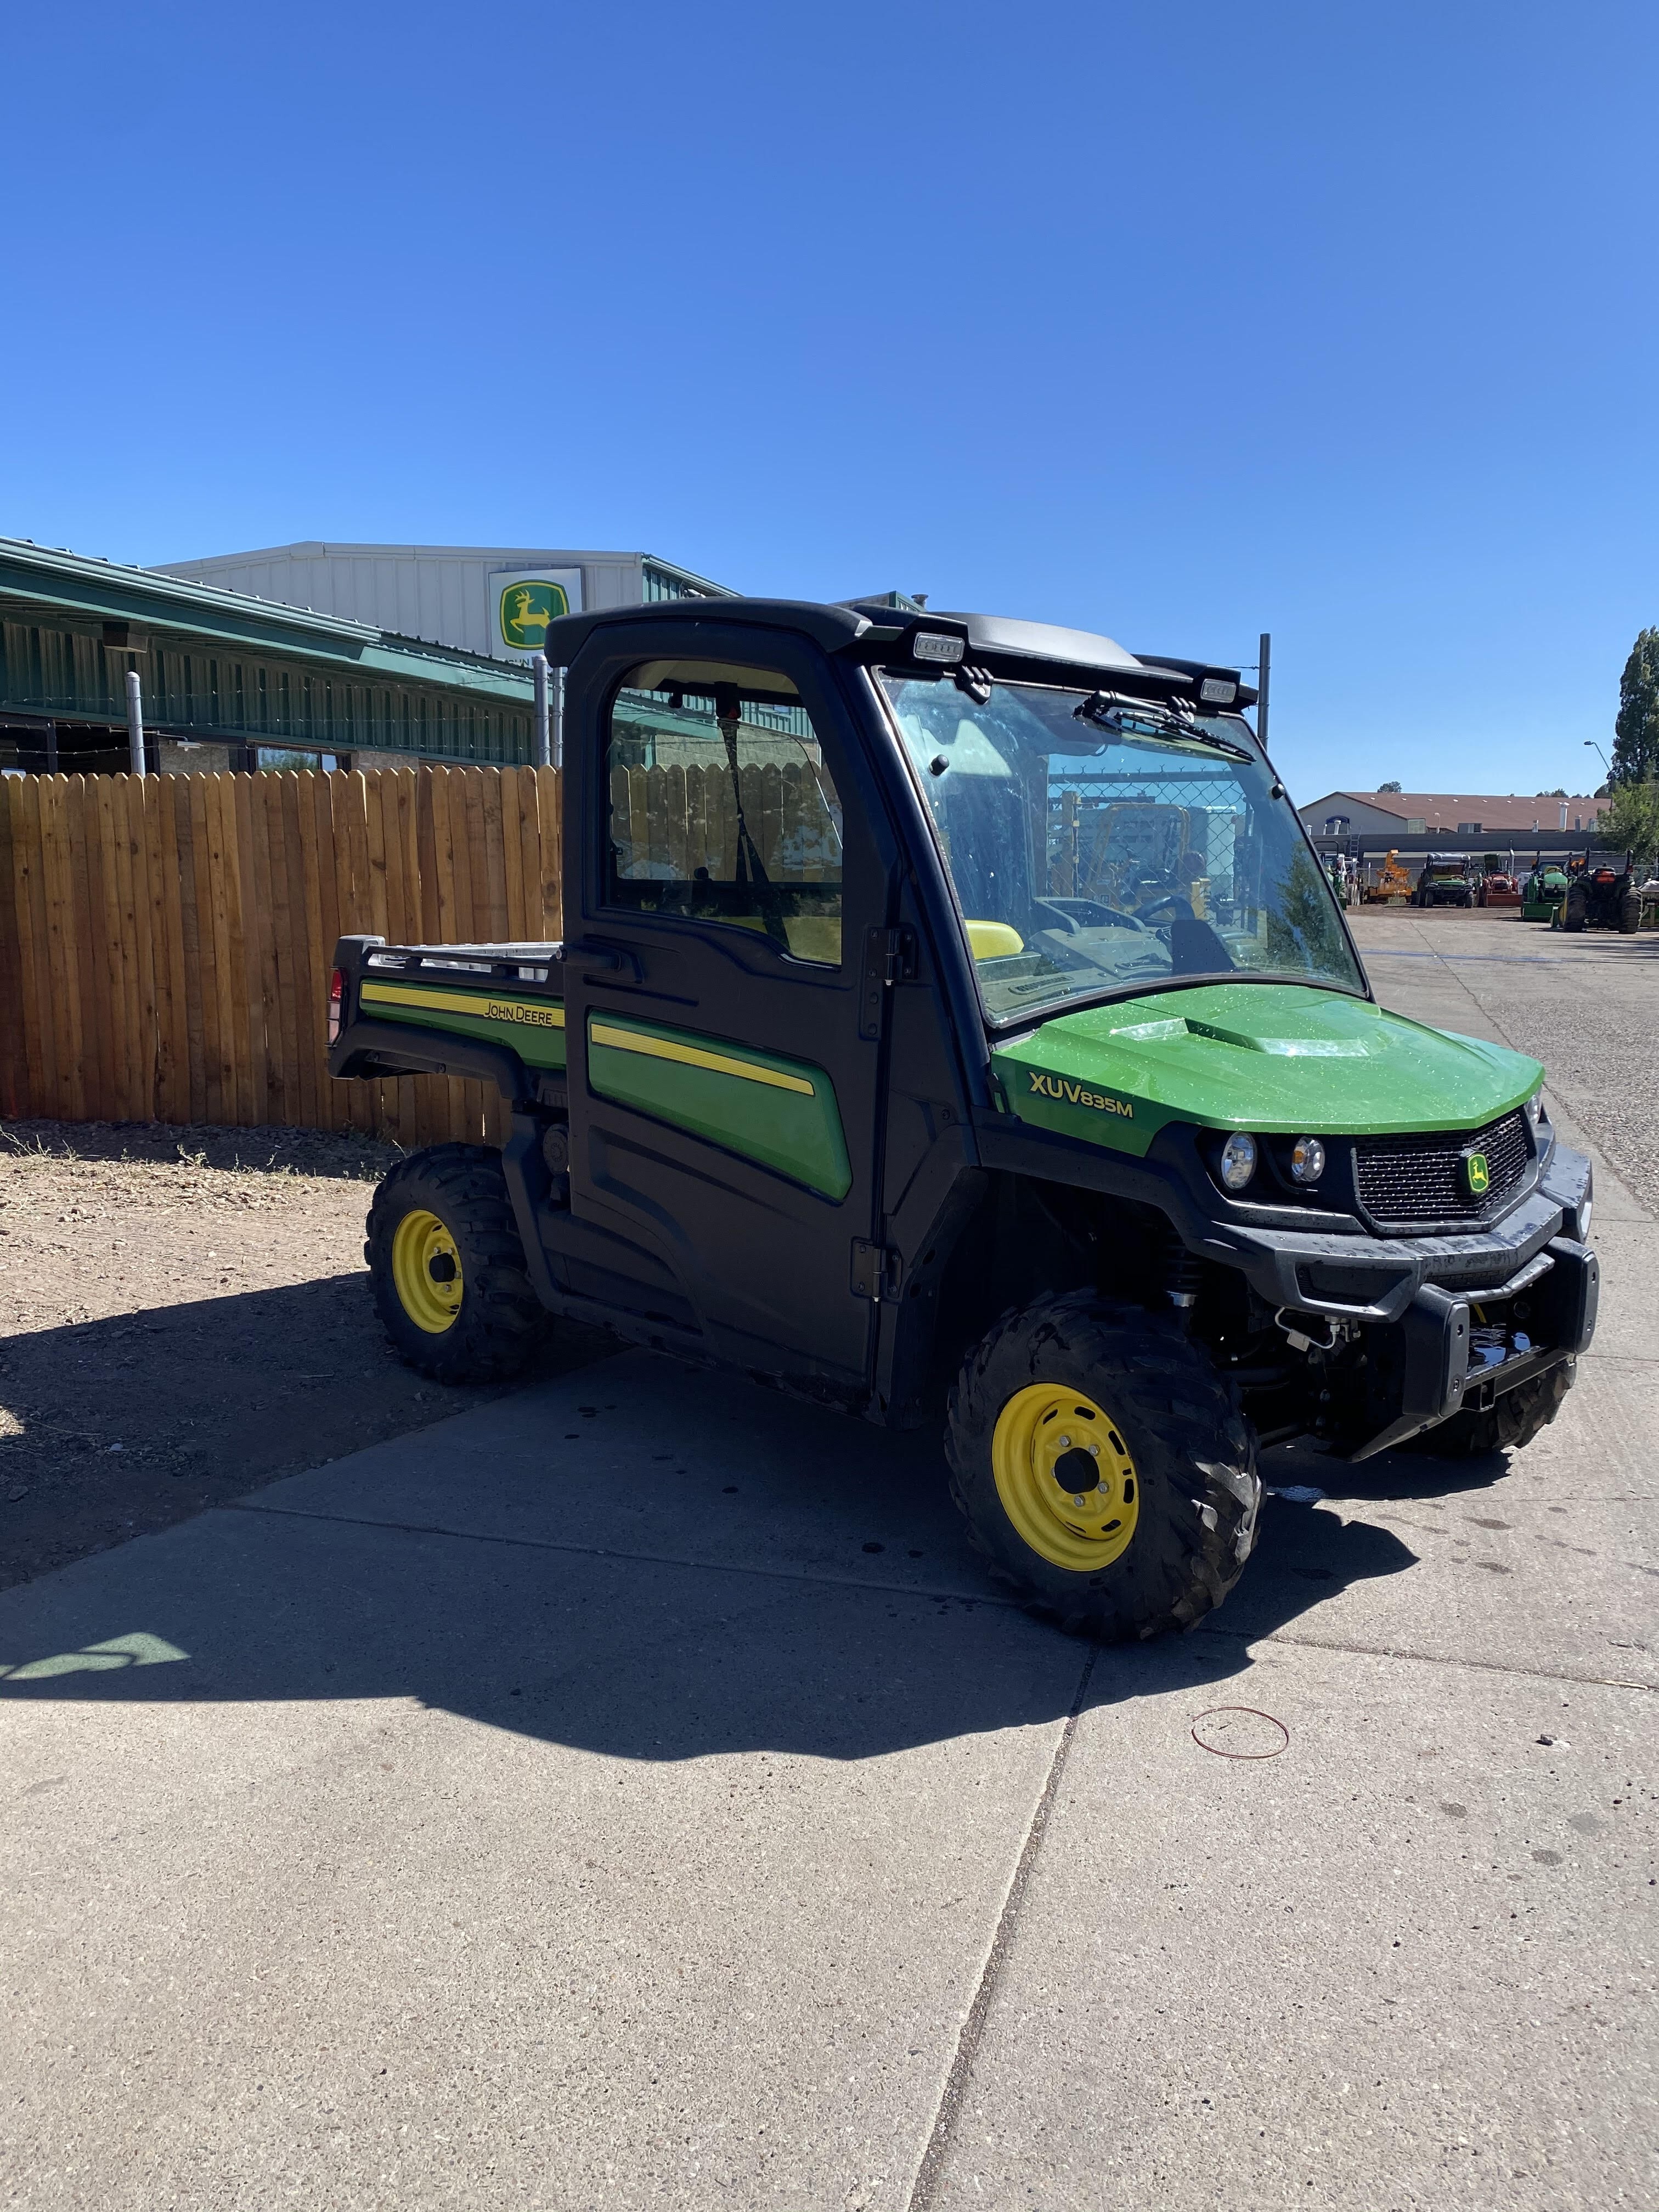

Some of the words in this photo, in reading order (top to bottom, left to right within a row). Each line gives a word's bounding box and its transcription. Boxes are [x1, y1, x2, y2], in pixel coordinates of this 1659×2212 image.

[485, 1002, 513, 1019] JOHN
[516, 1006, 552, 1024] DEERE
[1029, 1071, 1133, 1118] XUV835M
